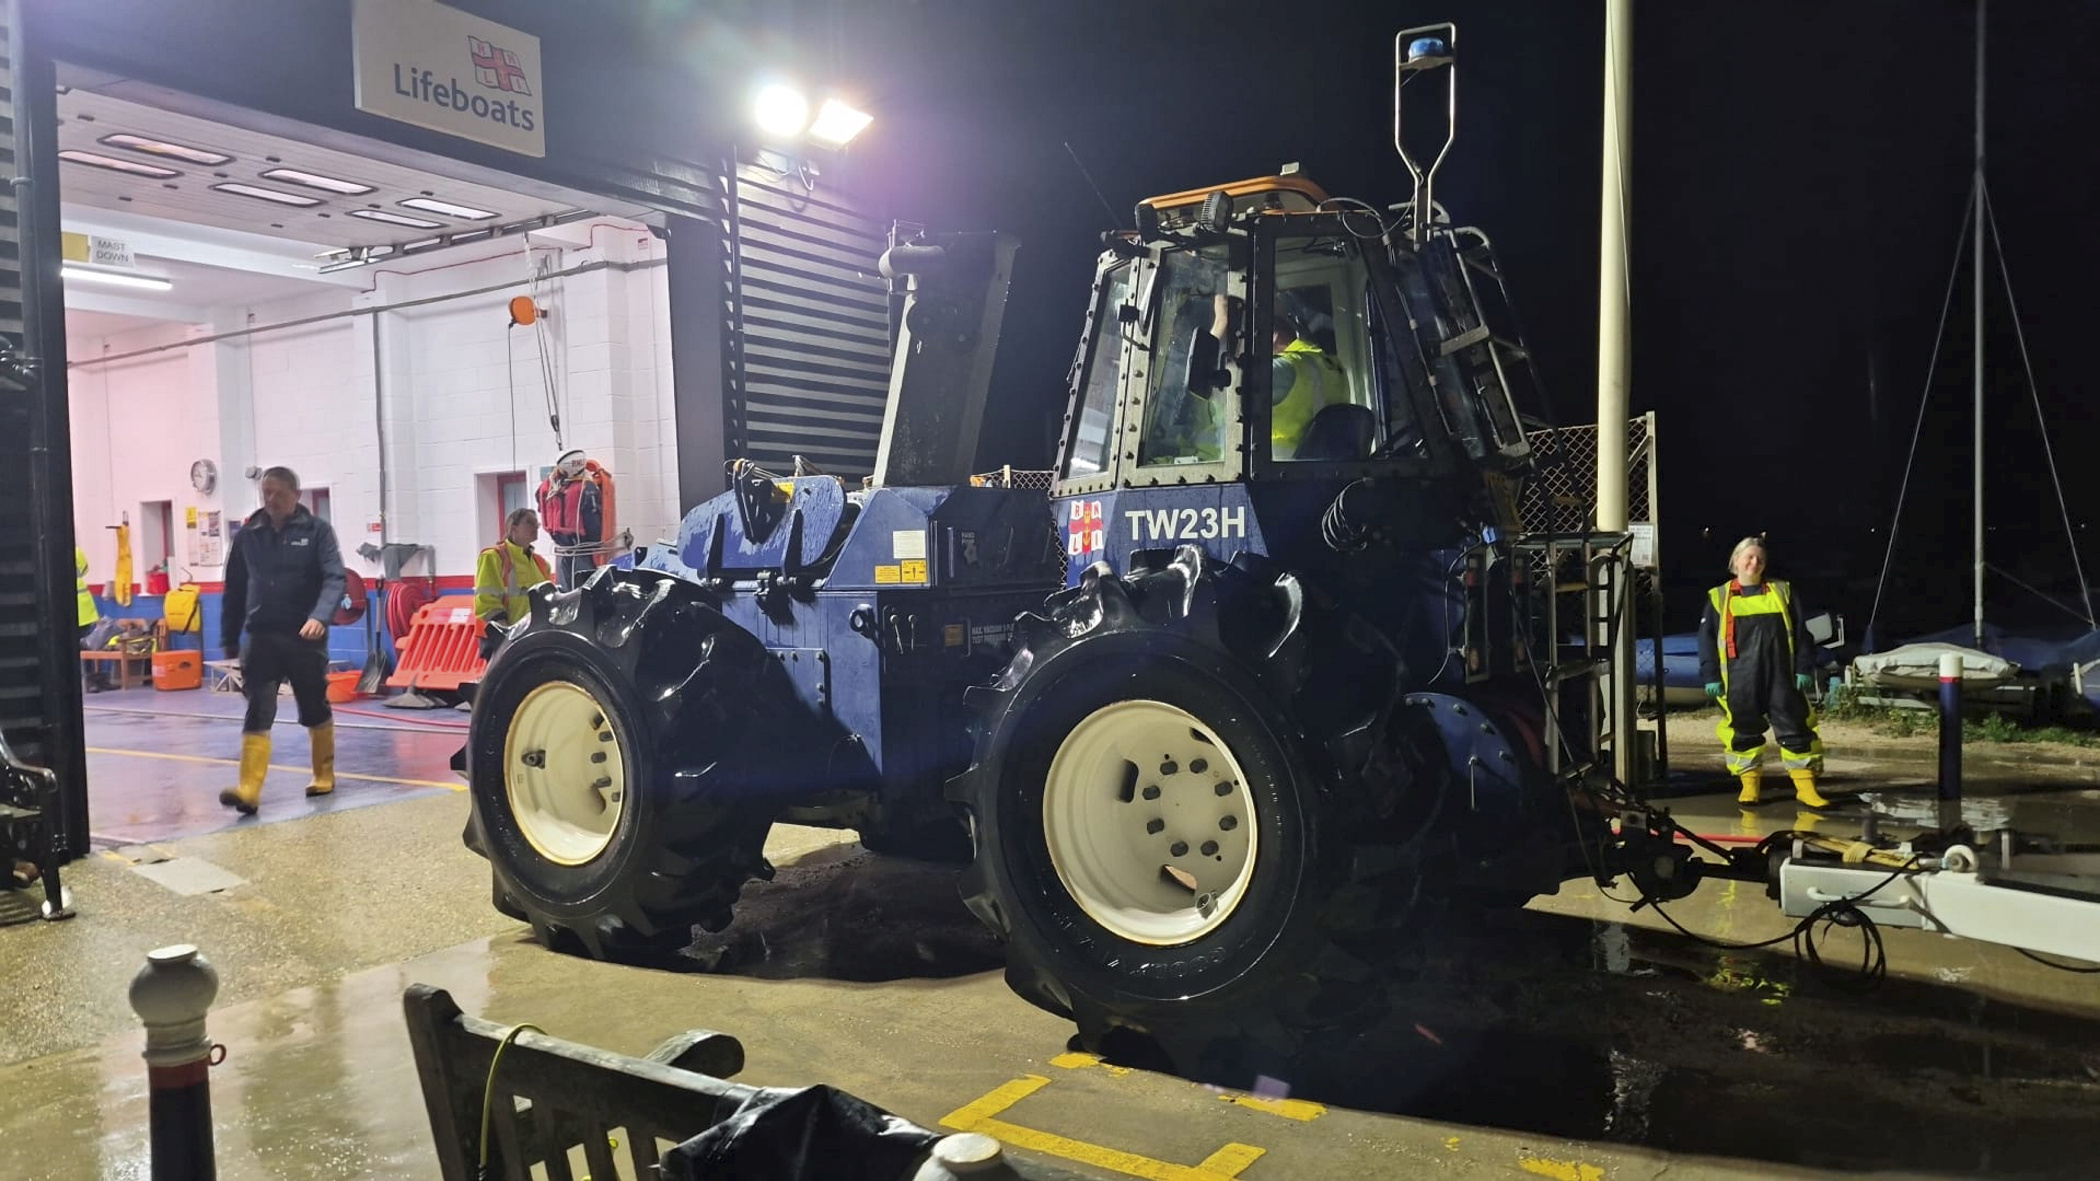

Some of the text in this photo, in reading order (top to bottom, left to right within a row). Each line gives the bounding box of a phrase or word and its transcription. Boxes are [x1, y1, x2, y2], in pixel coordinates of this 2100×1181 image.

[394, 63, 535, 131] Lifeboats
[96, 251, 129, 262] DOWN
[97, 240, 126, 251] MAST
[1125, 506, 1245, 541] TW23H
